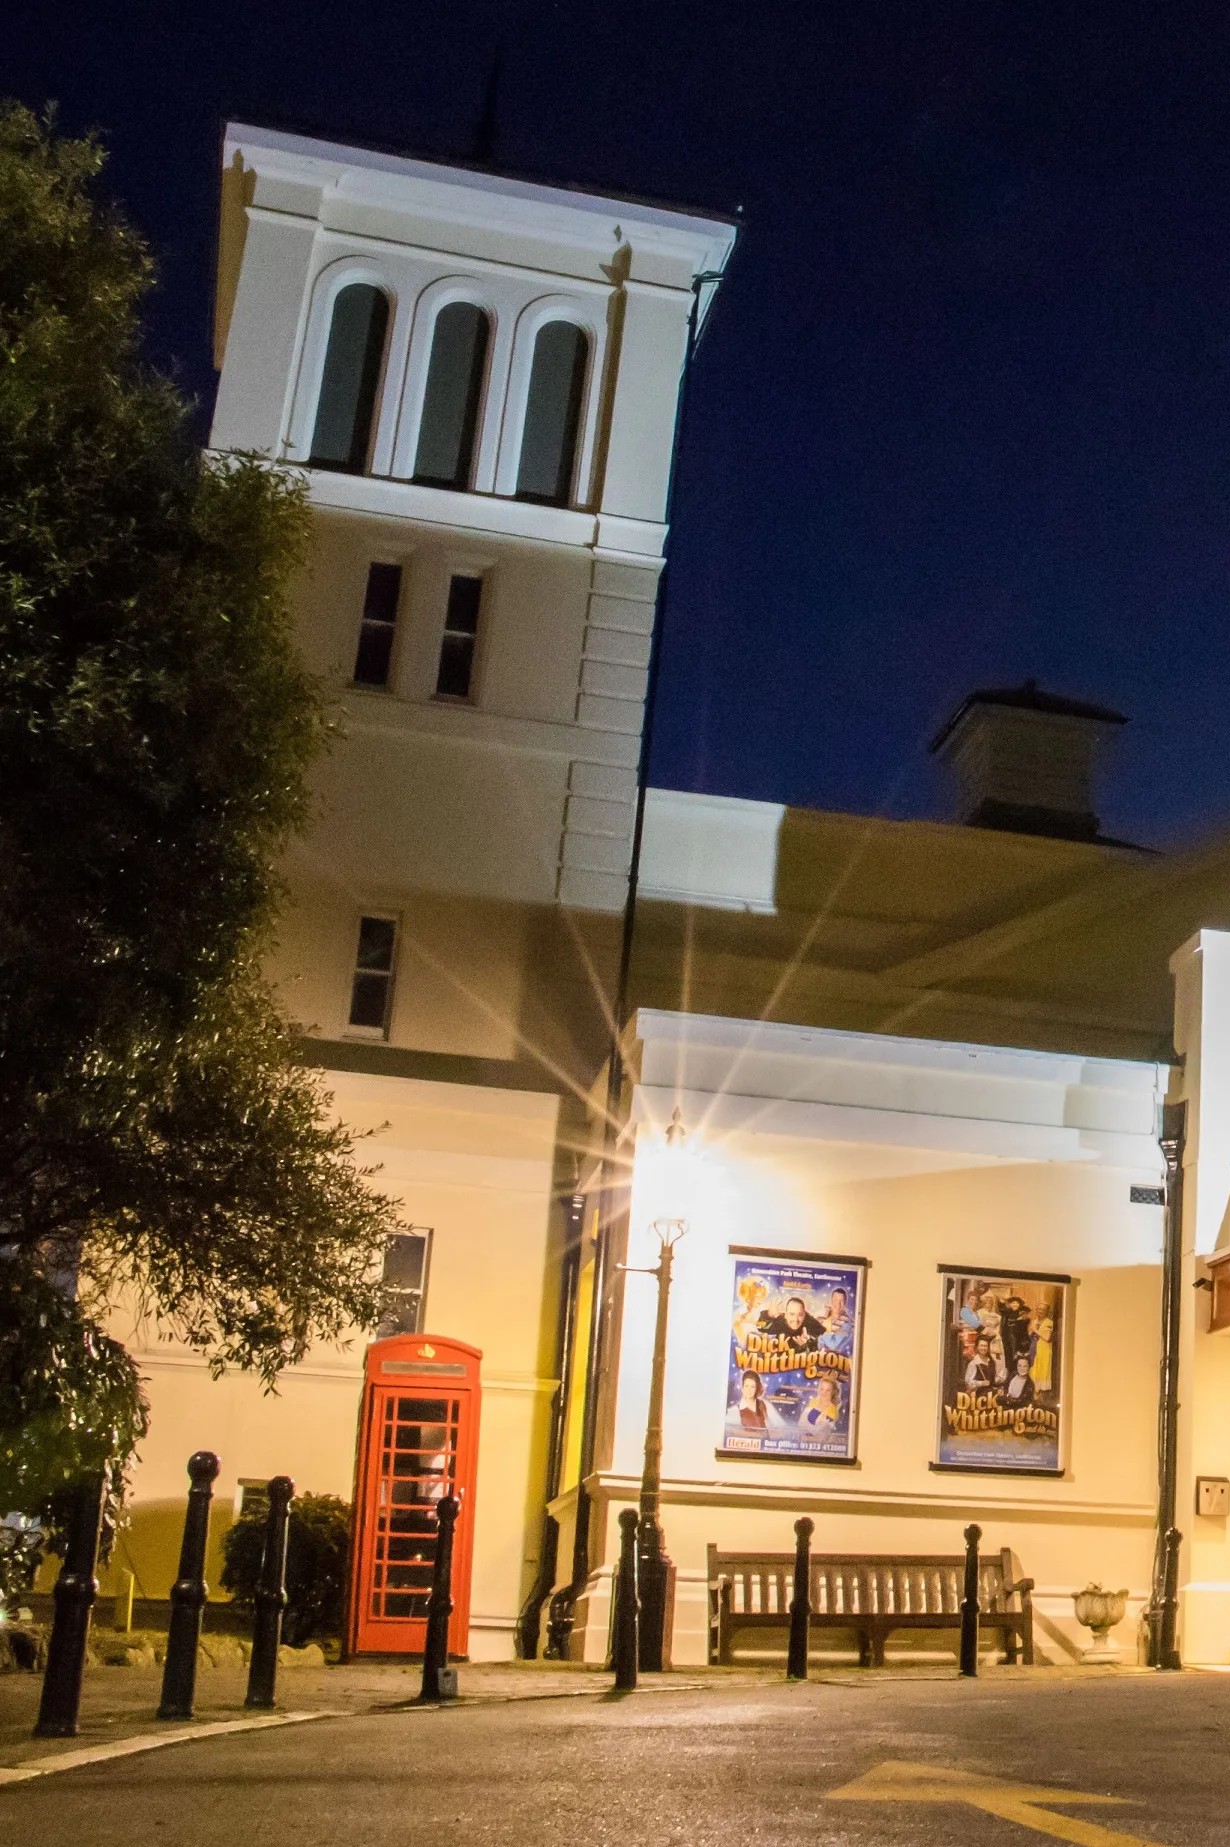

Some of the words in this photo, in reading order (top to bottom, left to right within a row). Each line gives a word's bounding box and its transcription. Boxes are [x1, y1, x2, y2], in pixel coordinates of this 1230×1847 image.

[747, 1333, 790, 1352] Dick
[735, 1346, 853, 1379] Whittington
[957, 1392, 999, 1410] Dick
[944, 1403, 1057, 1434] Whittington
[728, 1438, 760, 1449] Herald
